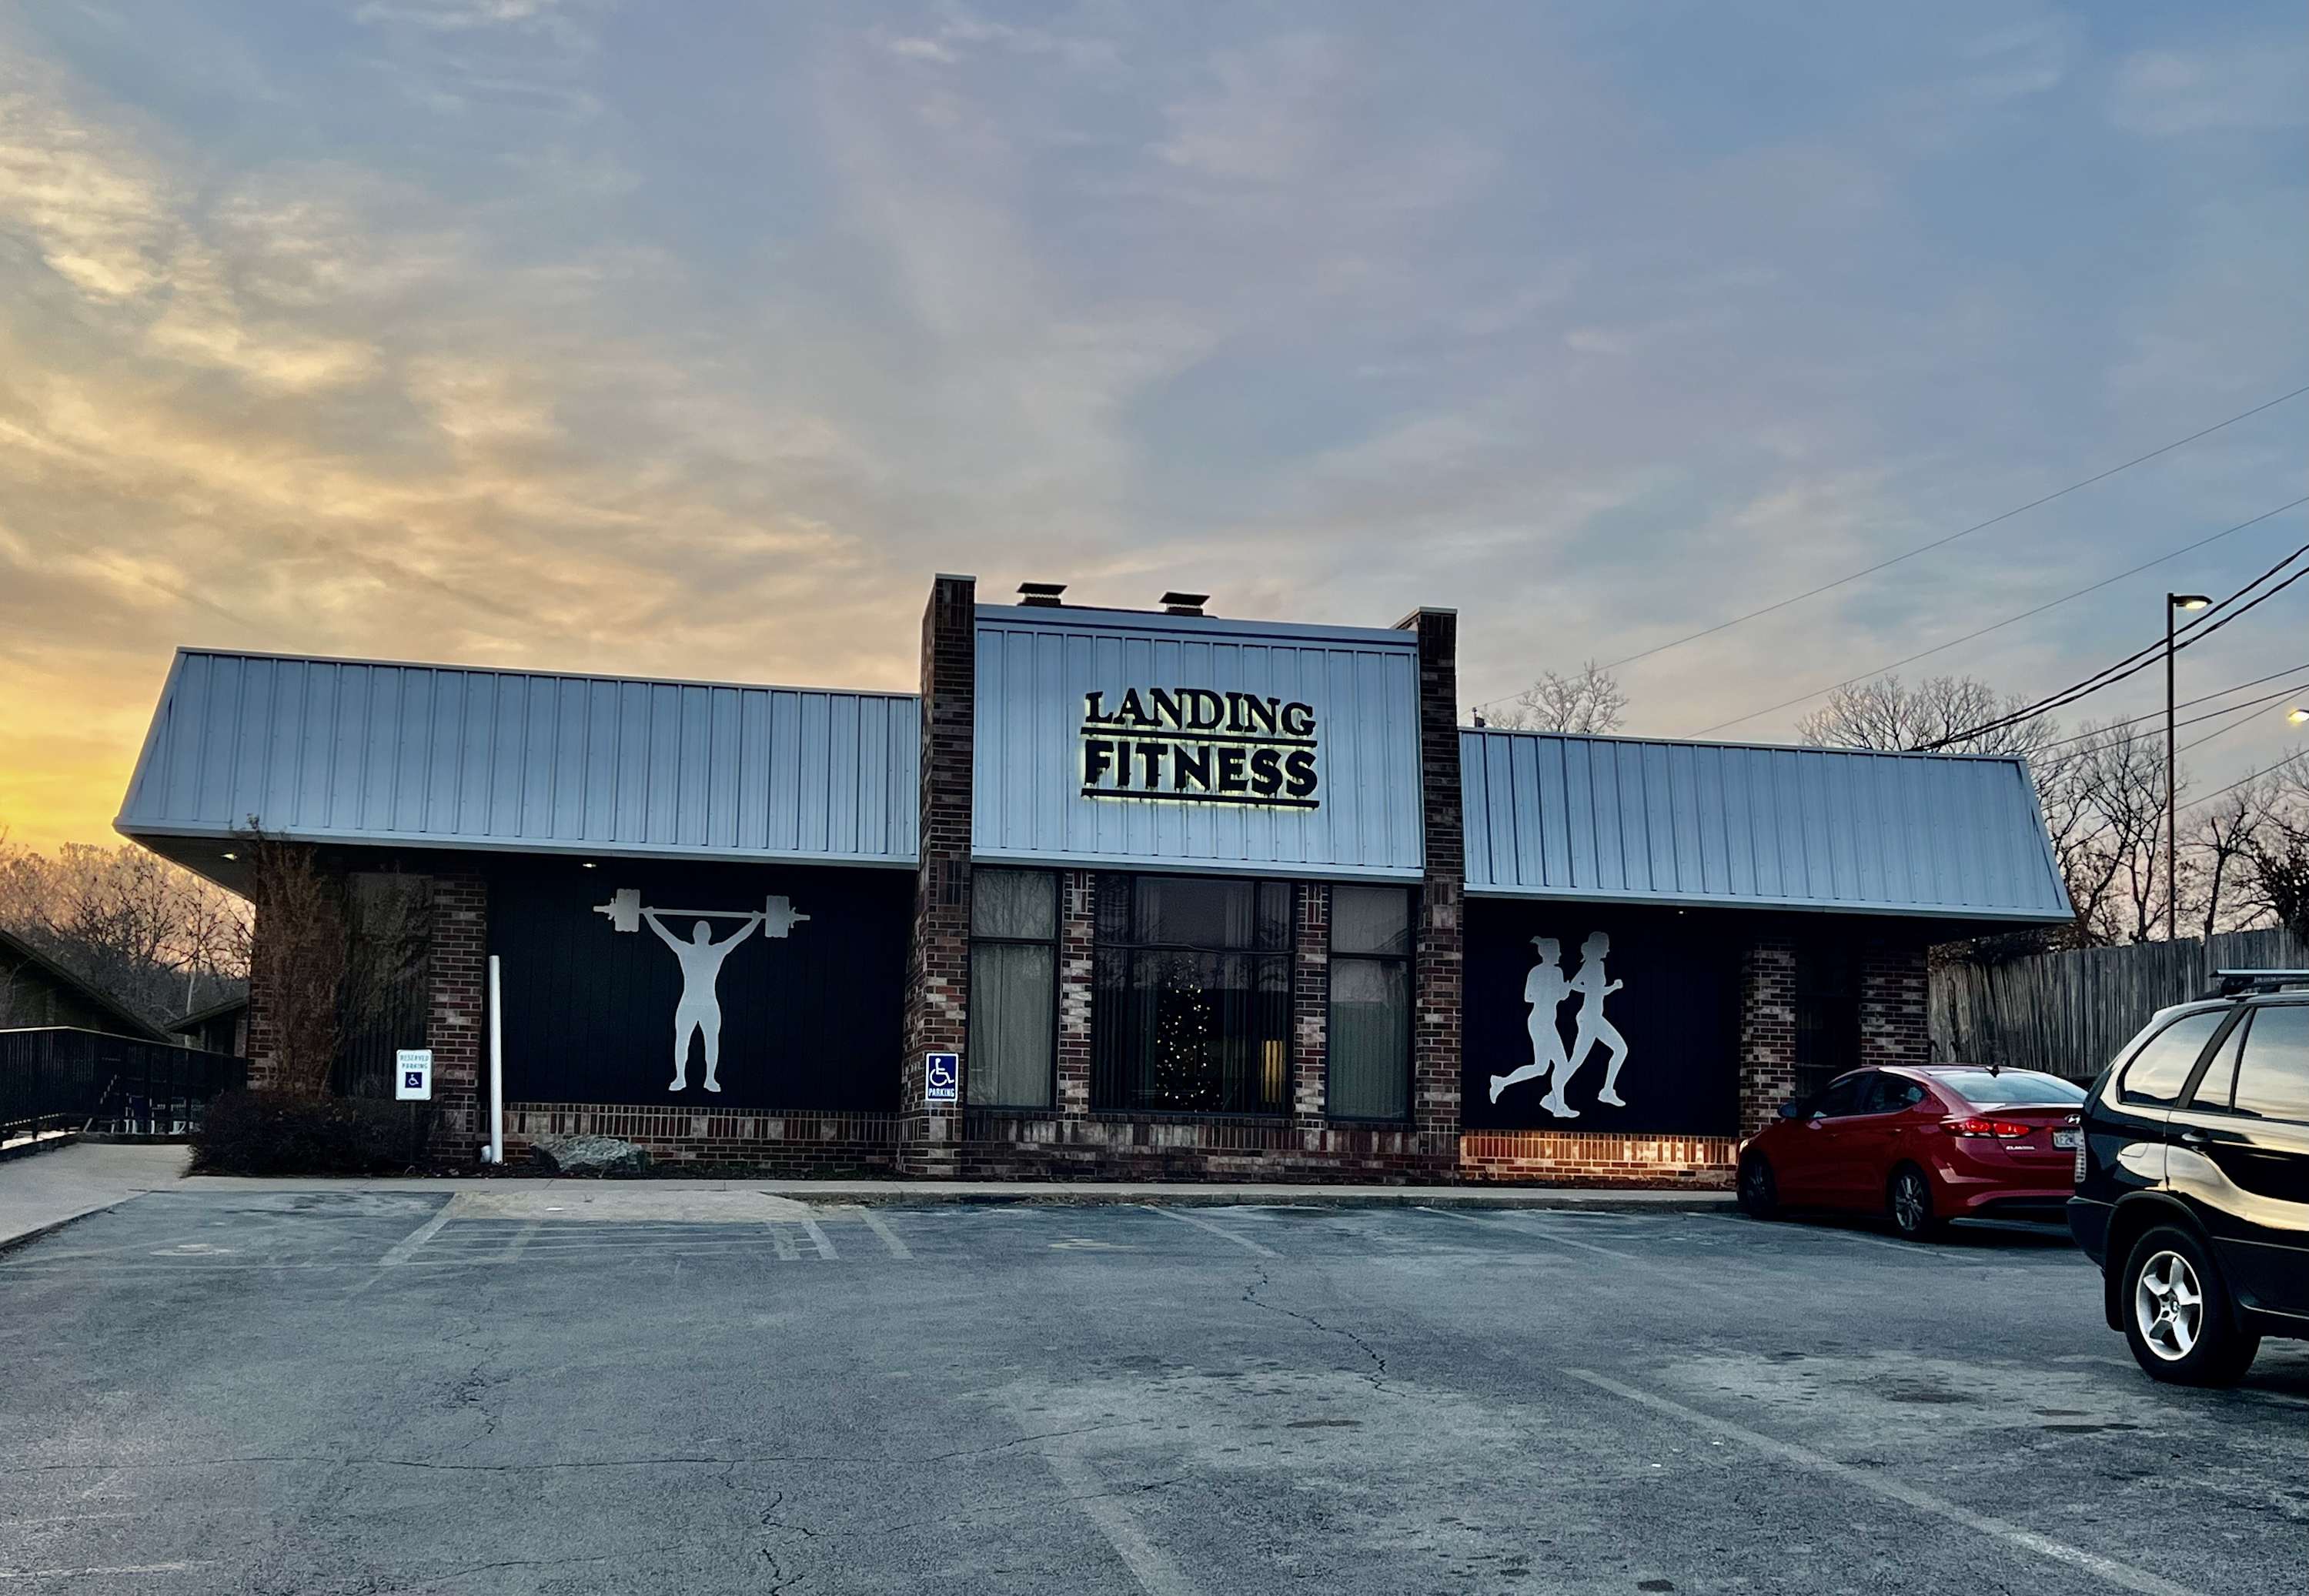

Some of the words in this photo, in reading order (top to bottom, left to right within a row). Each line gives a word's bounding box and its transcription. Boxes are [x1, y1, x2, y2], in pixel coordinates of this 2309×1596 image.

[1084, 688, 1316, 736] LANDING
[1084, 740, 1318, 797] FITNESS
[928, 1087, 955, 1097] PARKING
